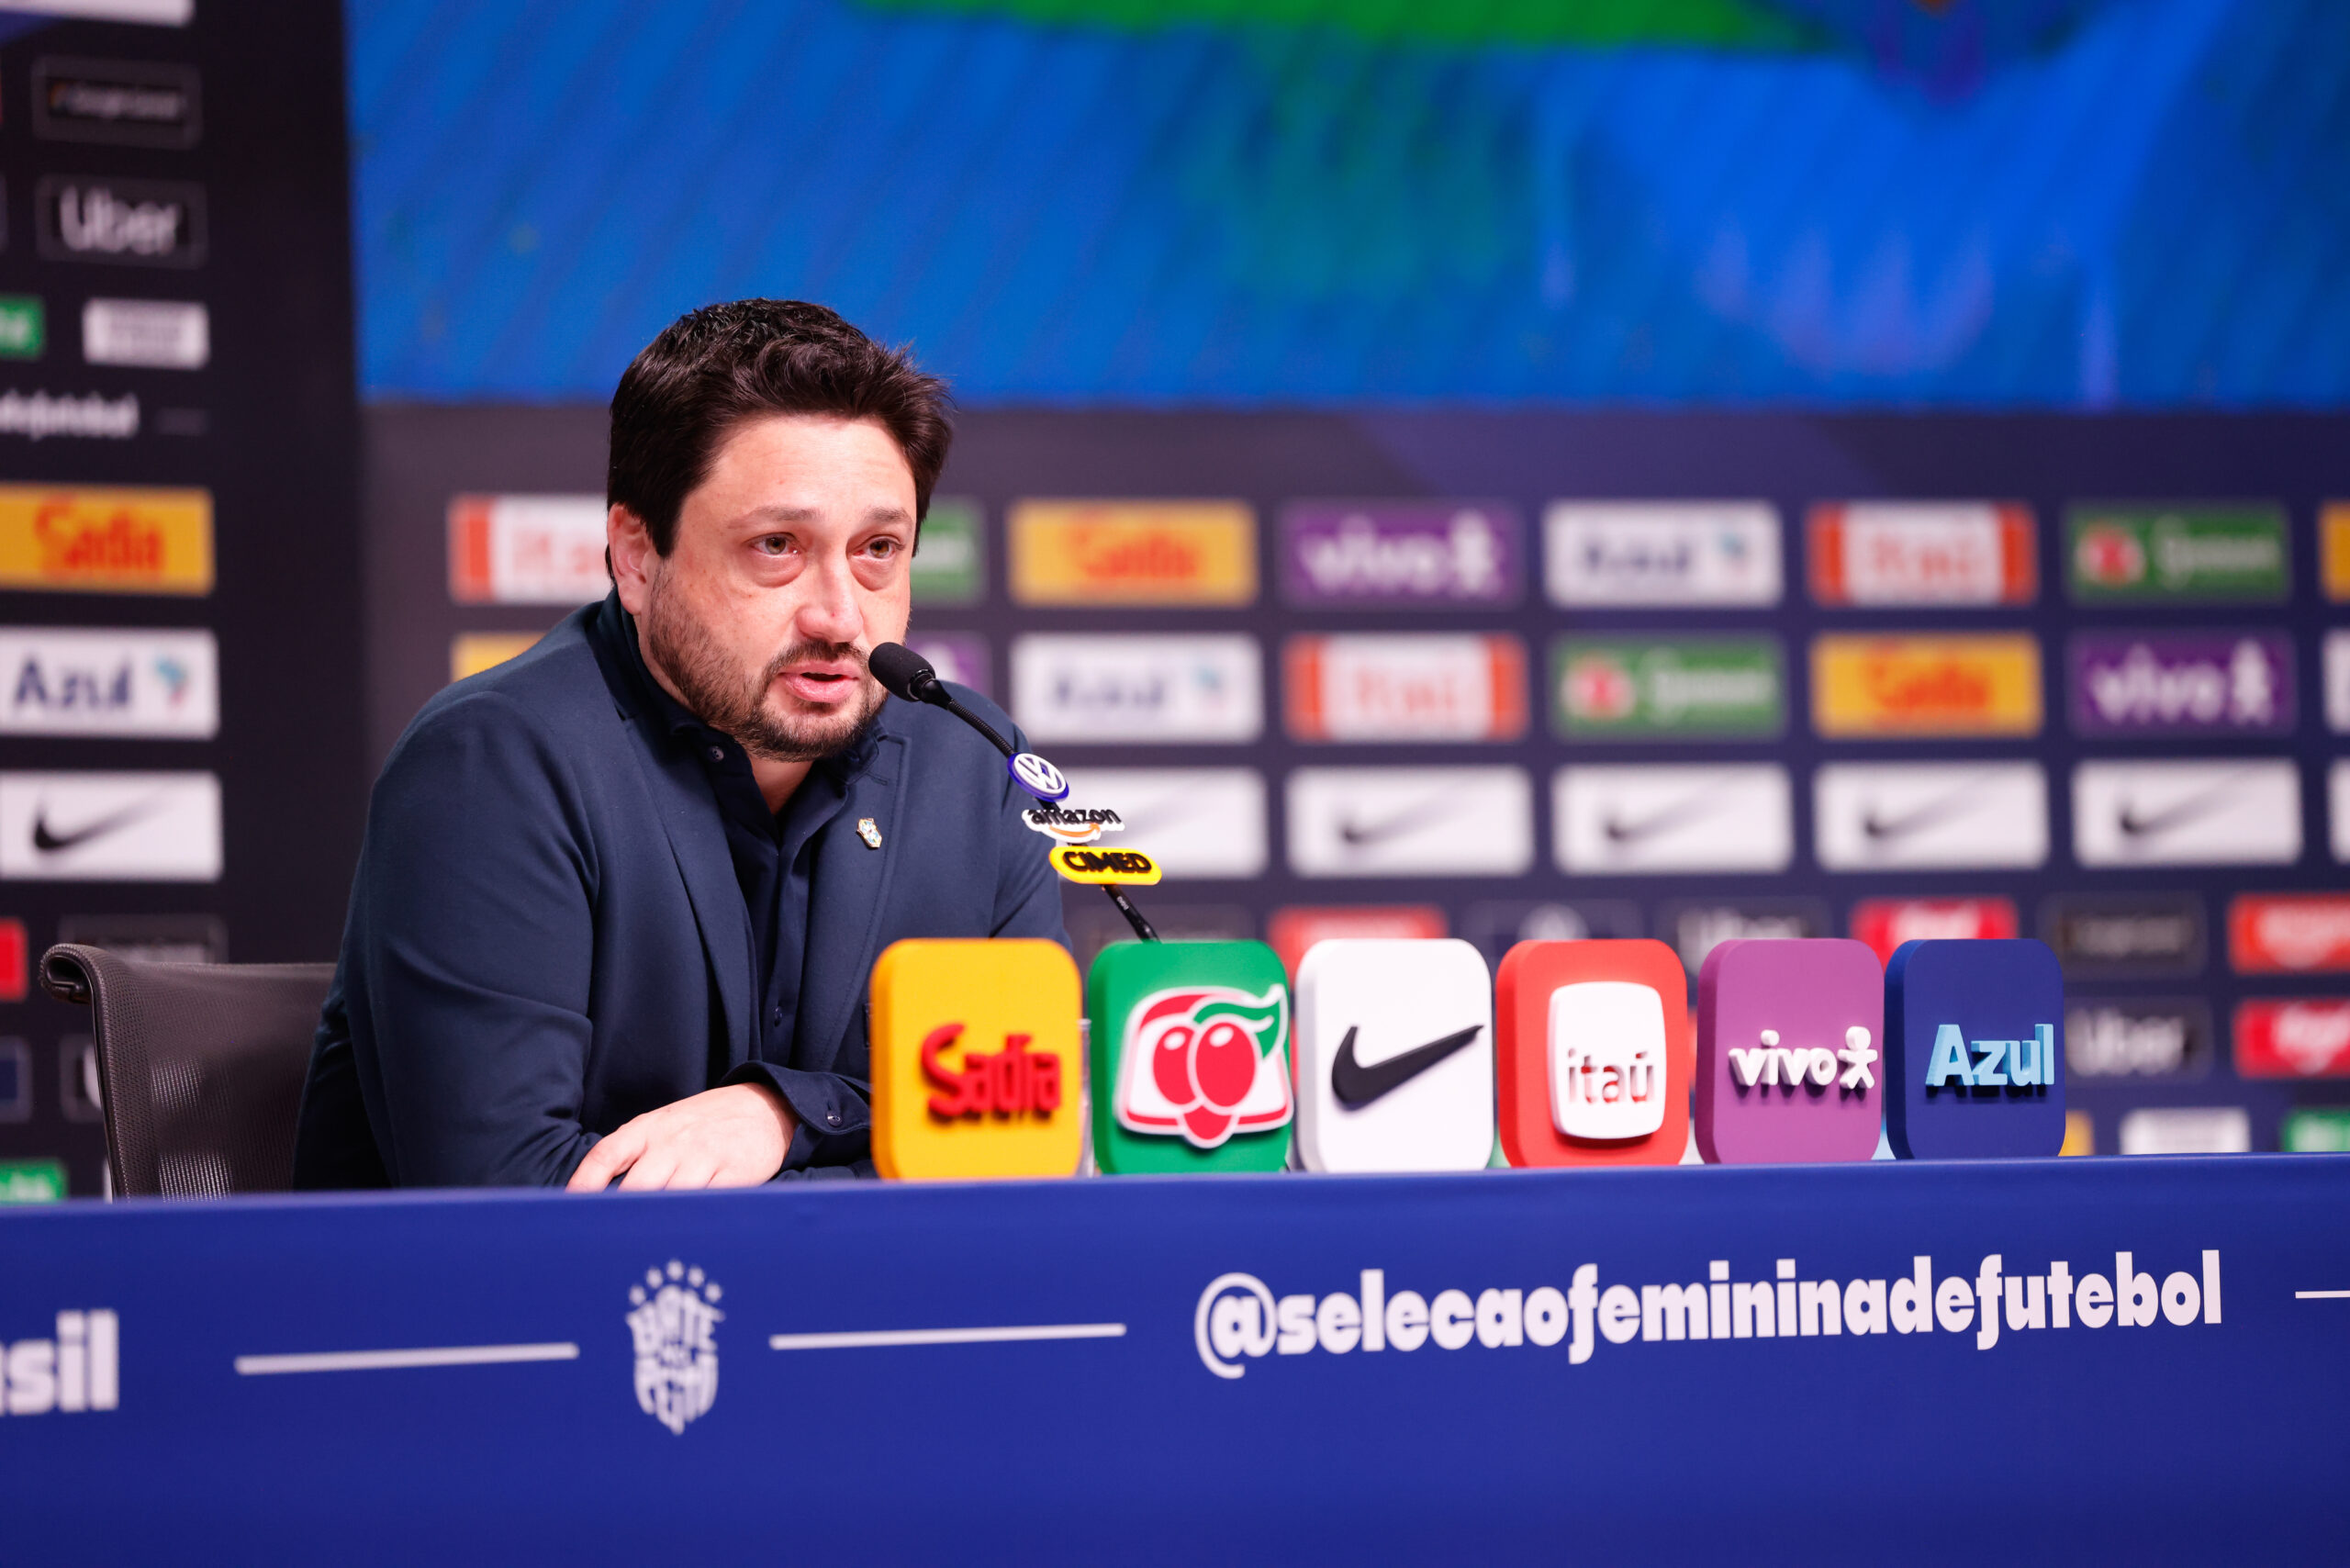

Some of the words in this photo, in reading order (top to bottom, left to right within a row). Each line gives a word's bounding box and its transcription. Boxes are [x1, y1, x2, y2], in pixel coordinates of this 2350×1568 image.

[1026, 809, 1122, 825] amazon
[1062, 851, 1152, 873] CIMED
[920, 1022, 1062, 1118] Sadia
[1567, 1047, 1654, 1103] itaú
[1728, 1029, 1838, 1087] vivo
[1925, 1024, 2055, 1087] Azul
[1194, 1249, 2222, 1379] @selecaofemininadefutebol
[0, 1307, 120, 1417] sil
